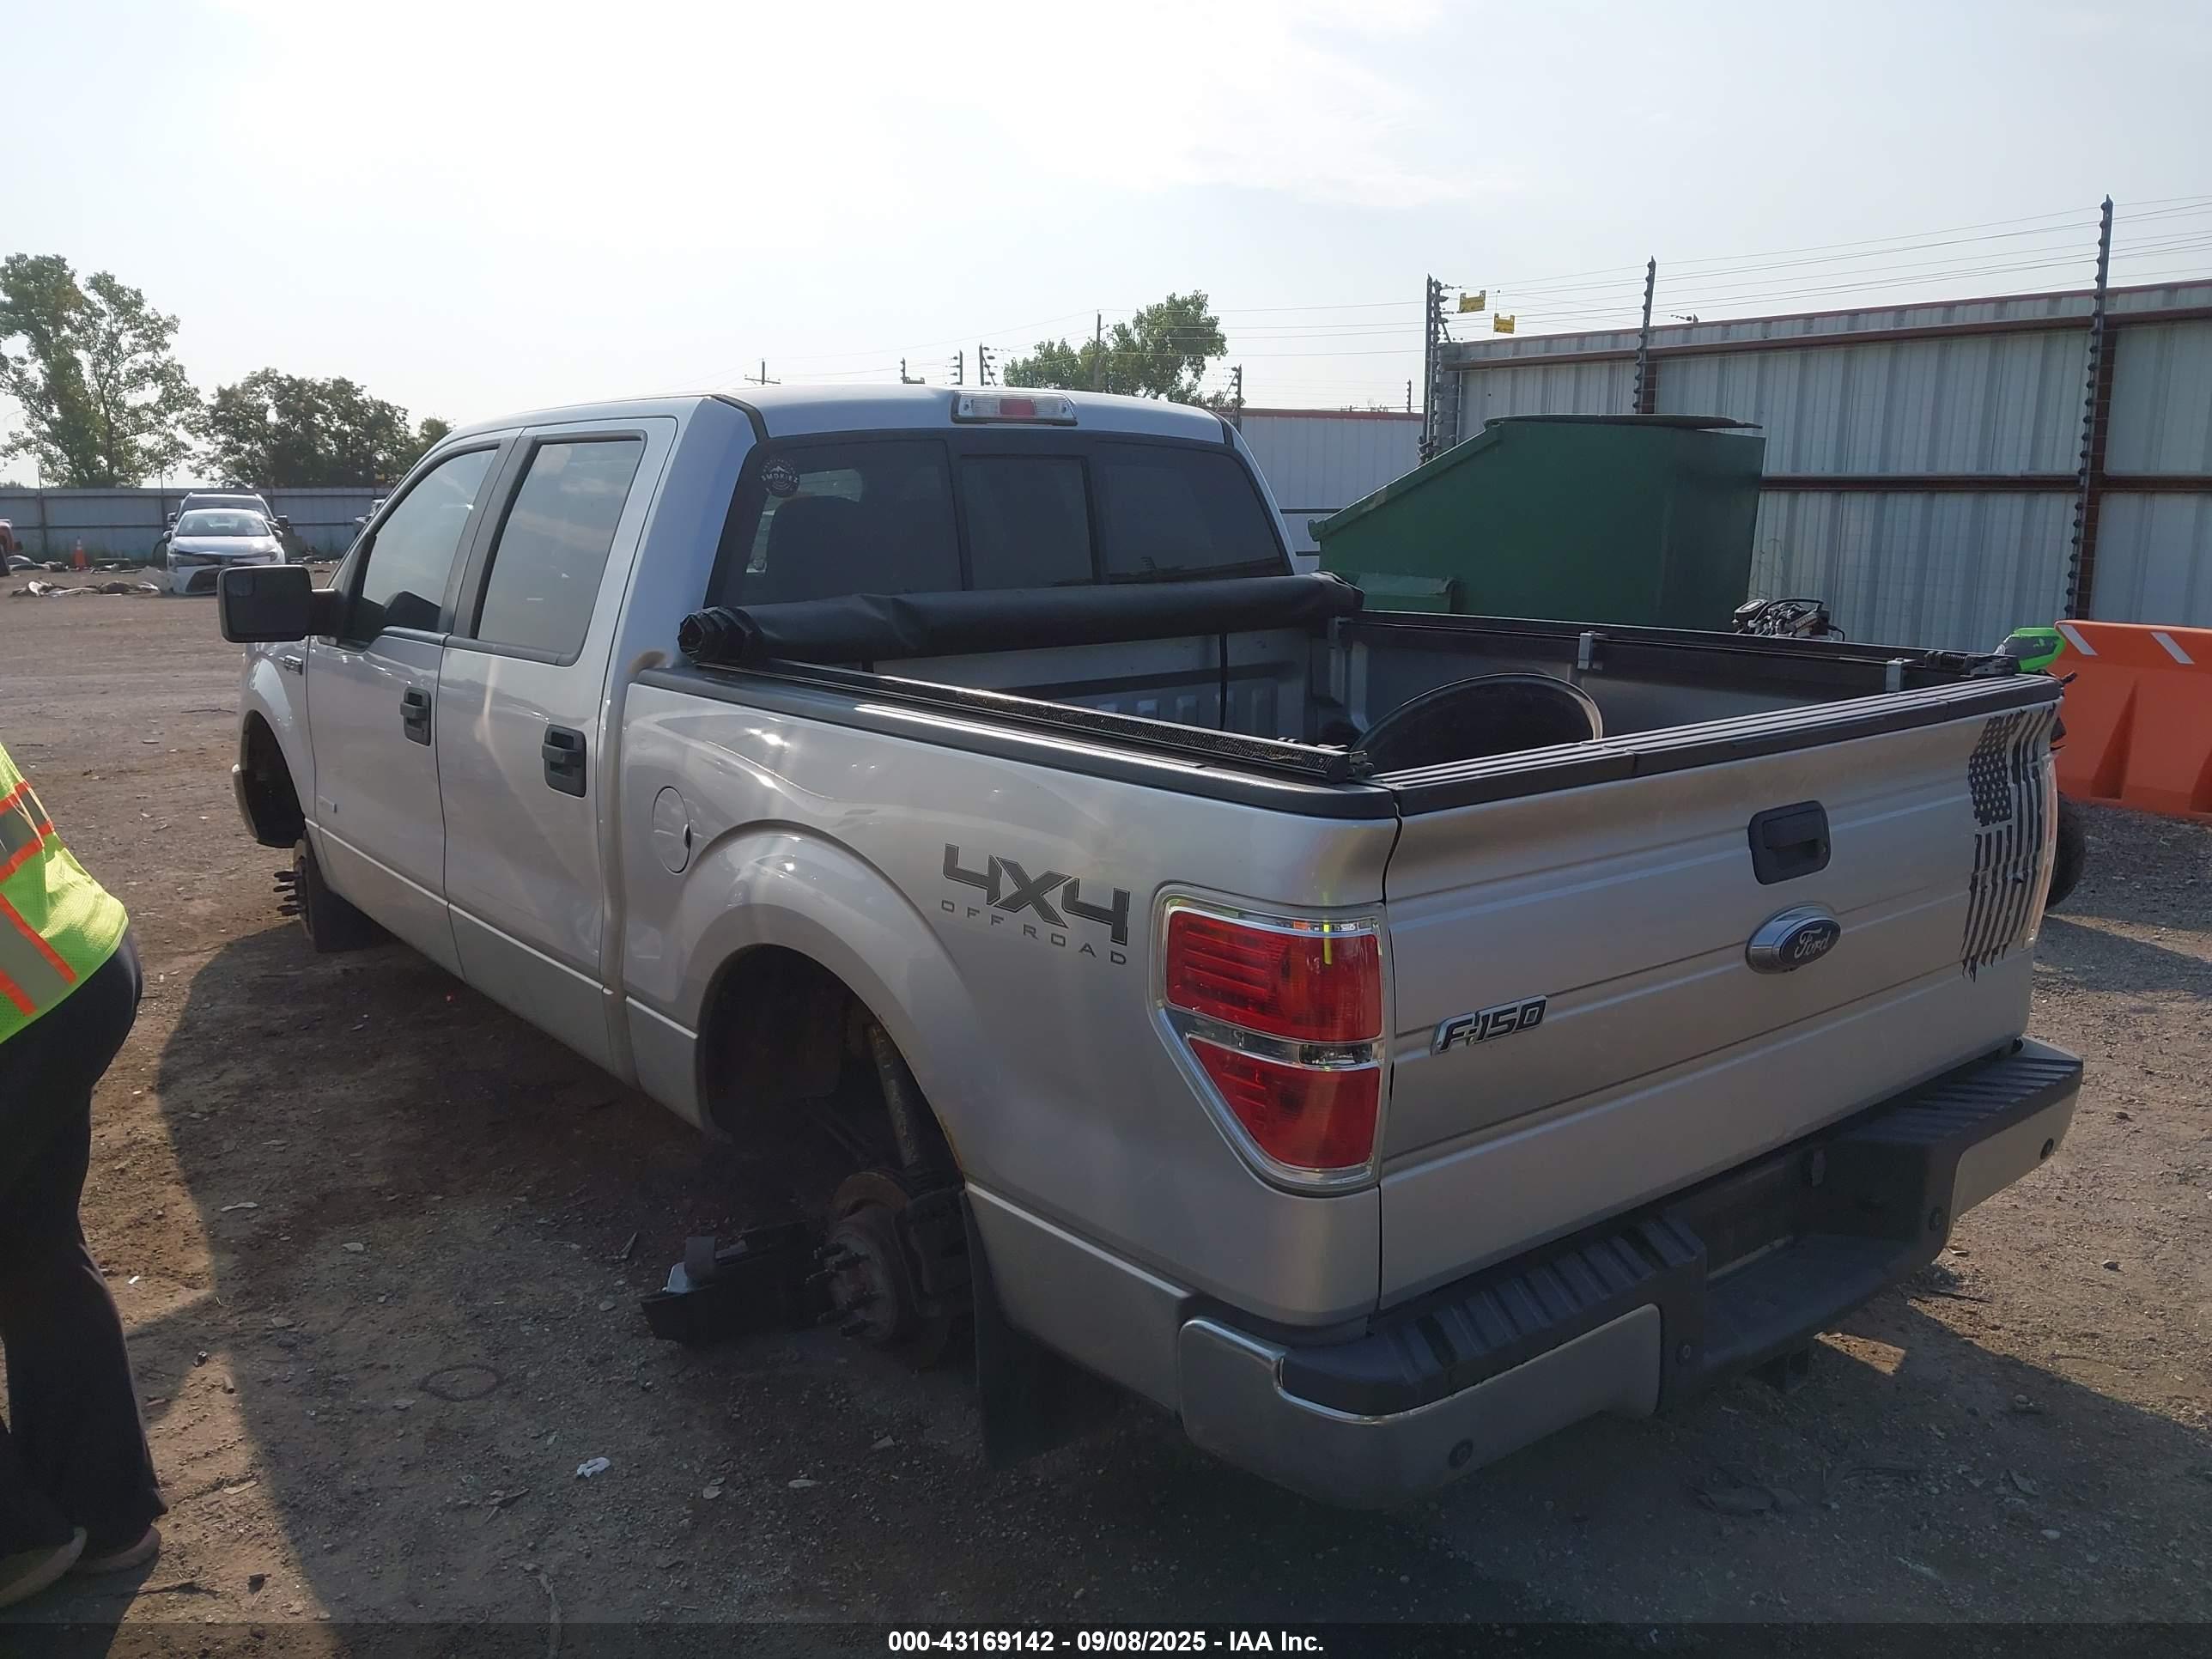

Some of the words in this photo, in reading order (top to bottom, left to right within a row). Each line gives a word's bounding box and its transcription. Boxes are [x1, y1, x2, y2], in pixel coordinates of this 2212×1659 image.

[941, 900, 1004, 926] OFF
[1023, 924, 1127, 965] ROAD
[1793, 927, 1832, 959] Ford
[1430, 994, 1548, 1056] F-150
